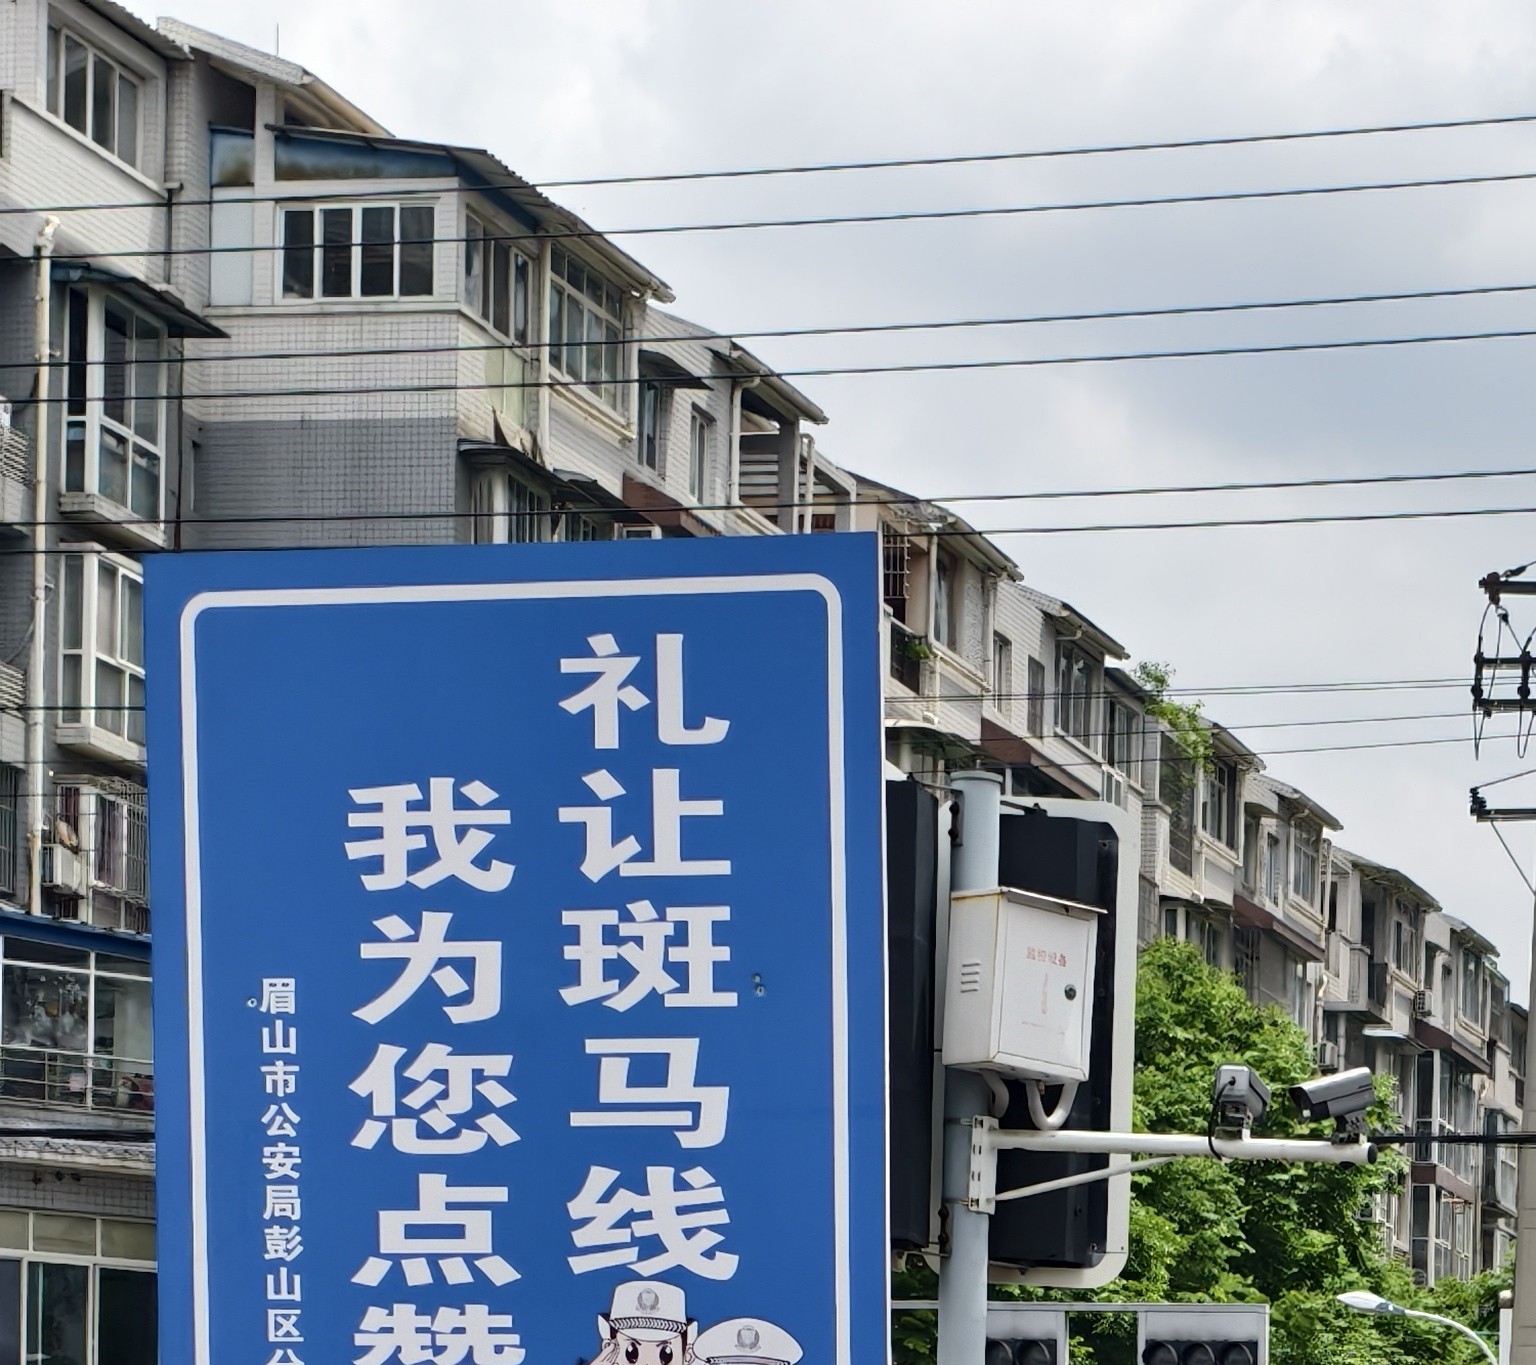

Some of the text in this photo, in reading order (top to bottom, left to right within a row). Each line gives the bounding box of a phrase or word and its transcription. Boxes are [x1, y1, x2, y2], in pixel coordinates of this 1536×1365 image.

[558, 631, 739, 1281] 礼让斑马线
